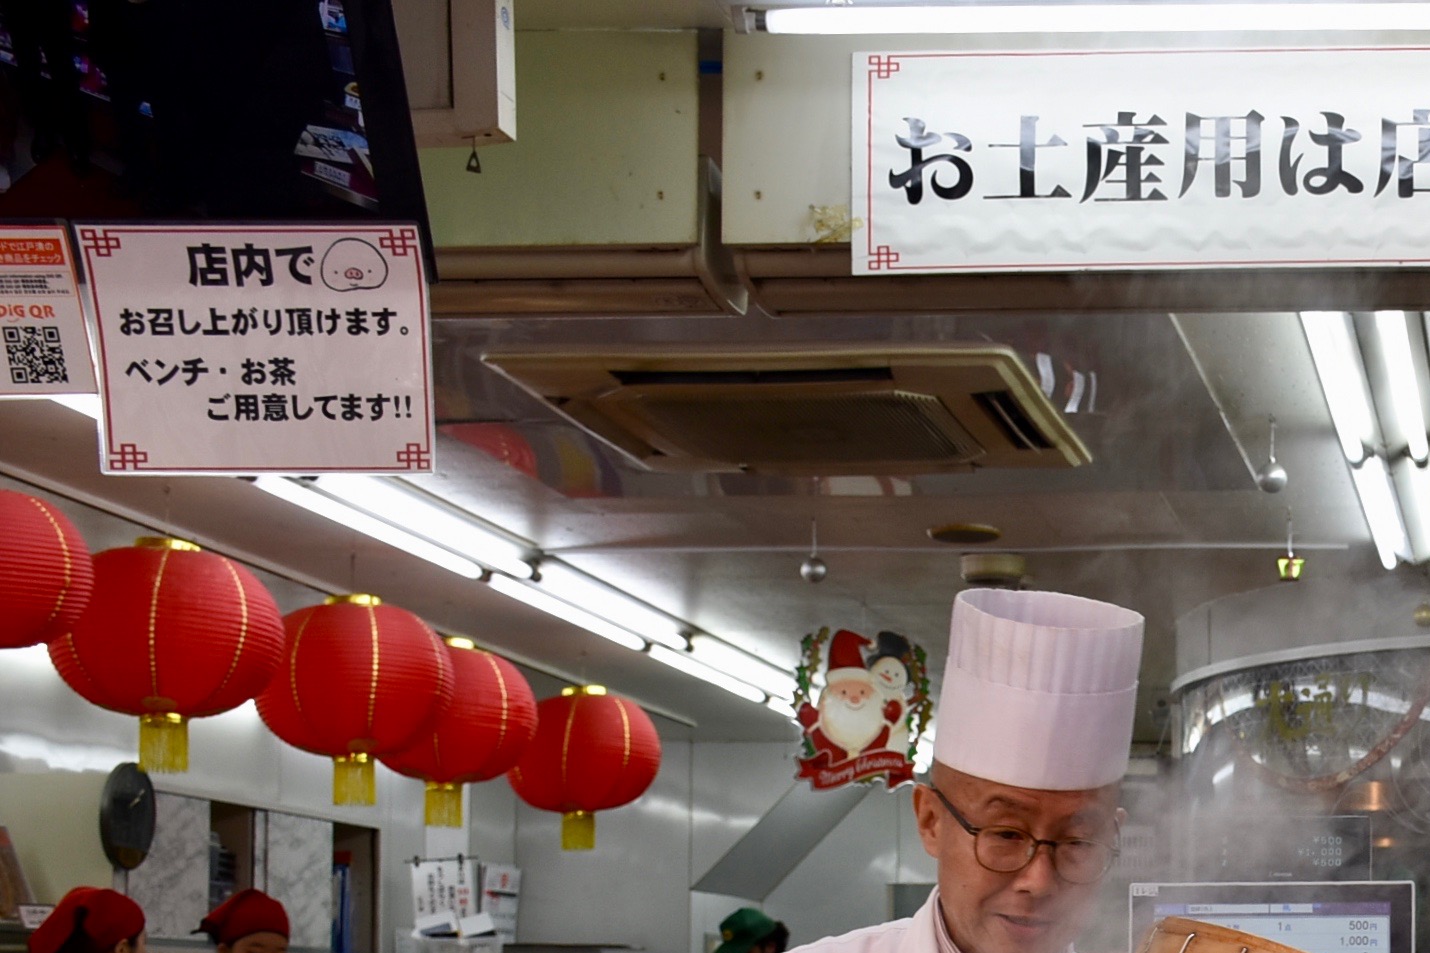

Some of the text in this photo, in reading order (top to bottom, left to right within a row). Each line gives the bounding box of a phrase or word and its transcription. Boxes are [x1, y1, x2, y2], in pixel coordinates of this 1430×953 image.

[186, 244, 315, 288] 店内で
[29, 304, 55, 319] QR
[119, 306, 410, 337] お召し上がり頂けます。
[125, 357, 296, 387] ベンチ・お茶
[205, 393, 413, 423] ご用意してます!!
[1349, 921, 1377, 931] 500円
